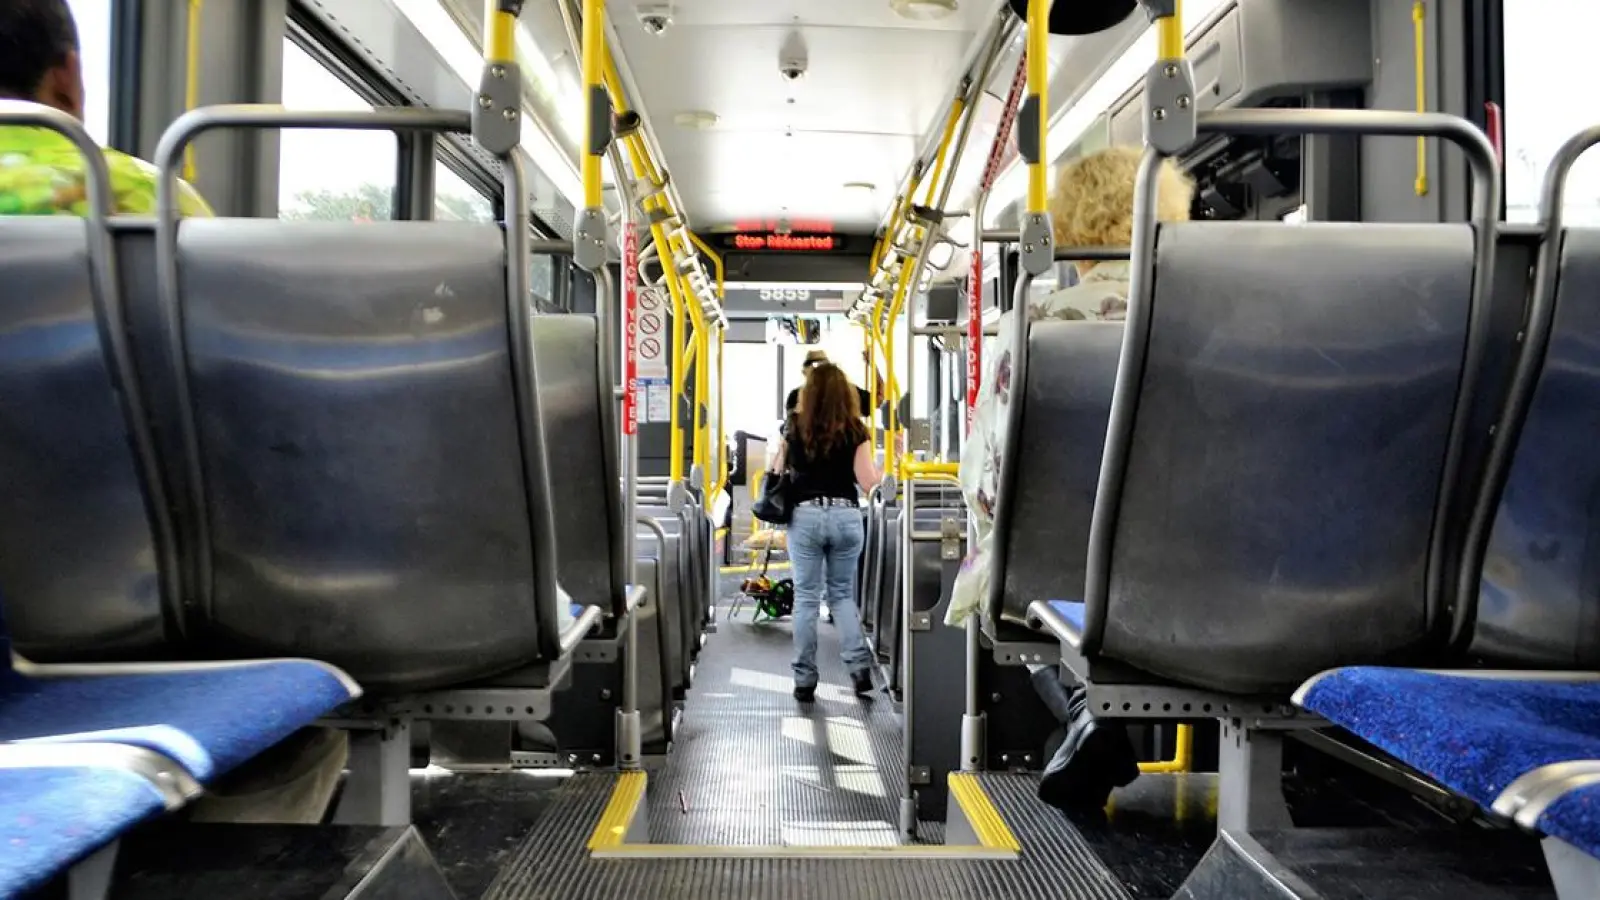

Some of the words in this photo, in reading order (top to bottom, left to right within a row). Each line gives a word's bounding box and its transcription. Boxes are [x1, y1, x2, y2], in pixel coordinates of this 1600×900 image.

[759, 289, 810, 301] 5859
[627, 307, 638, 363] YOUR
[967, 336, 977, 391] YOUR
[628, 378, 638, 433] STEP
